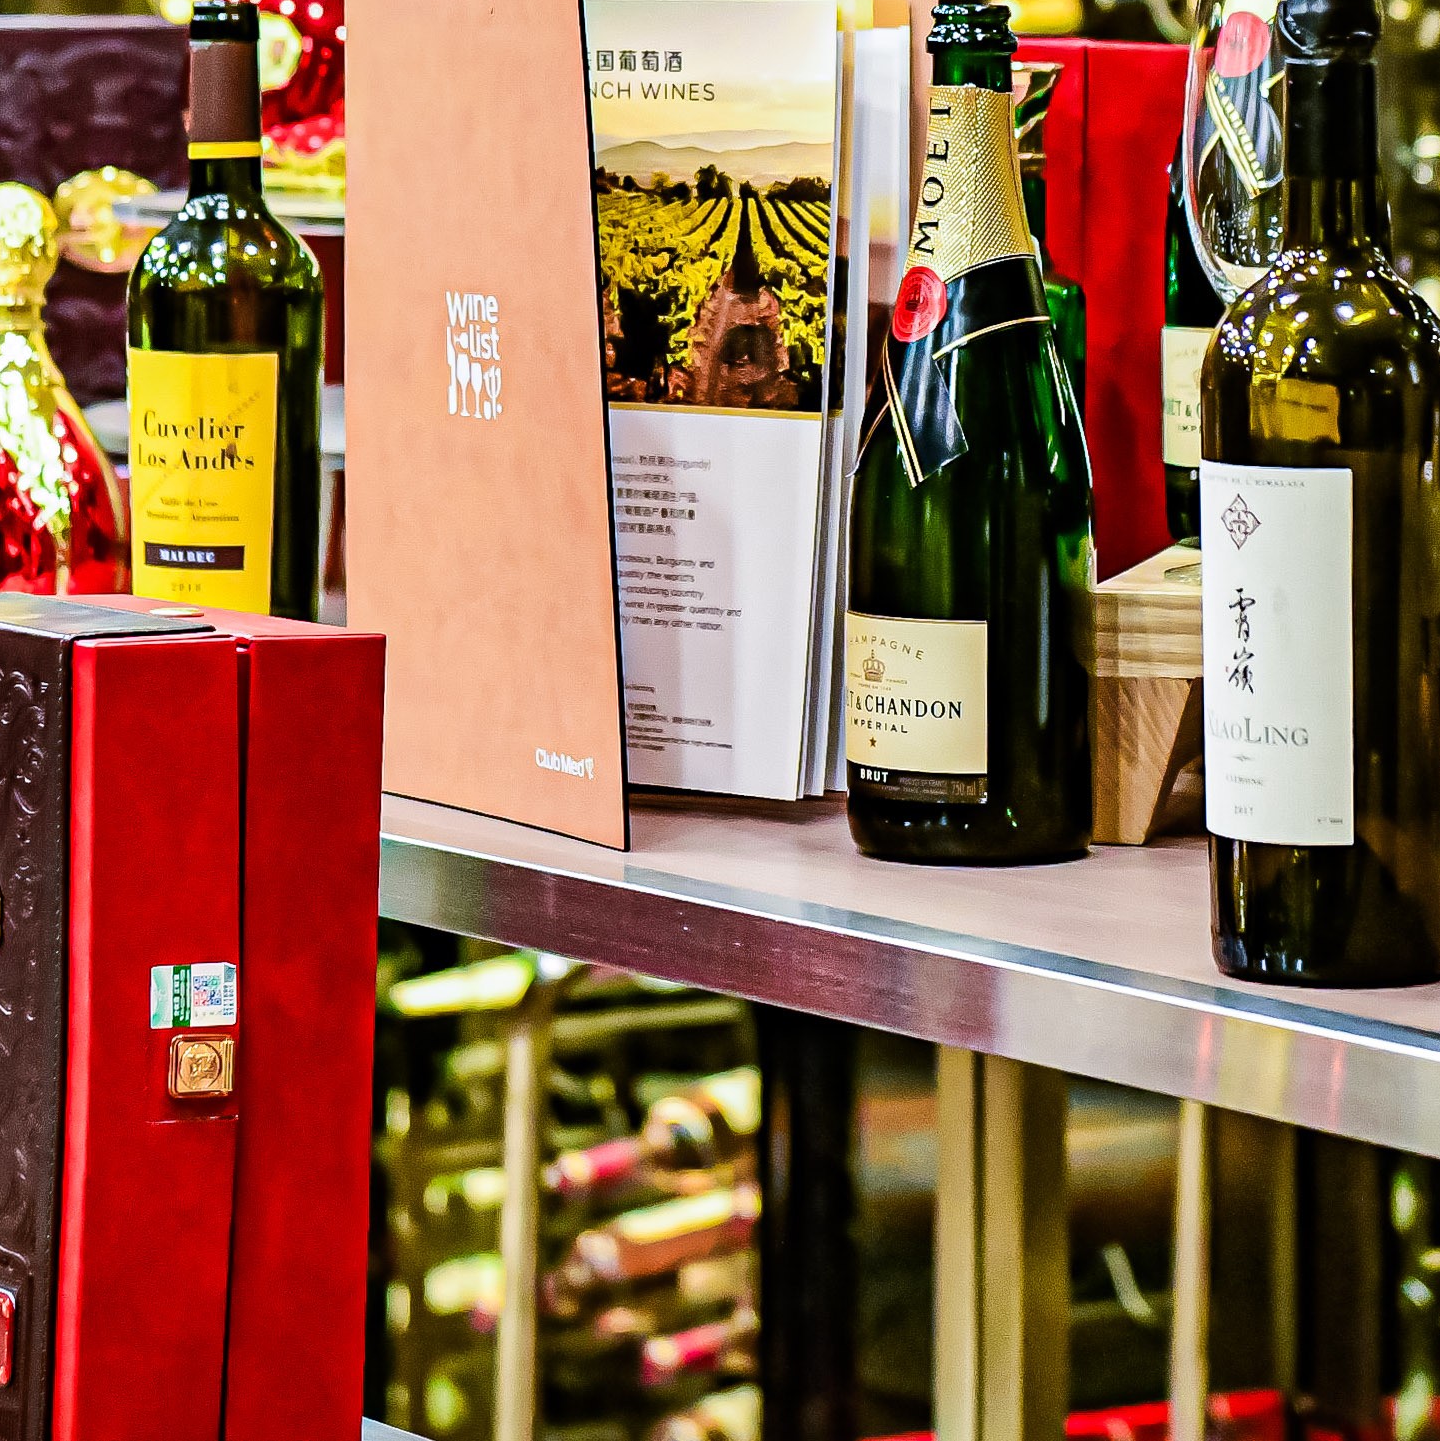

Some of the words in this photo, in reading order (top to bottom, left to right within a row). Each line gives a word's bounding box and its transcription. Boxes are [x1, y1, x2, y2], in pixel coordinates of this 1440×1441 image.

[588, 49, 682, 72] 国葡萄酒
[640, 82, 715, 101] WINES
[469, 324, 501, 361] list
[143, 410, 245, 441] Cuvelier
[138, 443, 167, 468] Los
[179, 448, 256, 472] Andes
[159, 547, 216, 564] MALBEC
[849, 635, 925, 661] AMPAGNE
[864, 695, 963, 720] CHANDON
[850, 717, 909, 735] IMPÉRIAL
[535, 747, 561, 772] Club
[560, 752, 586, 779] Med
[860, 768, 889, 784] BRUT
